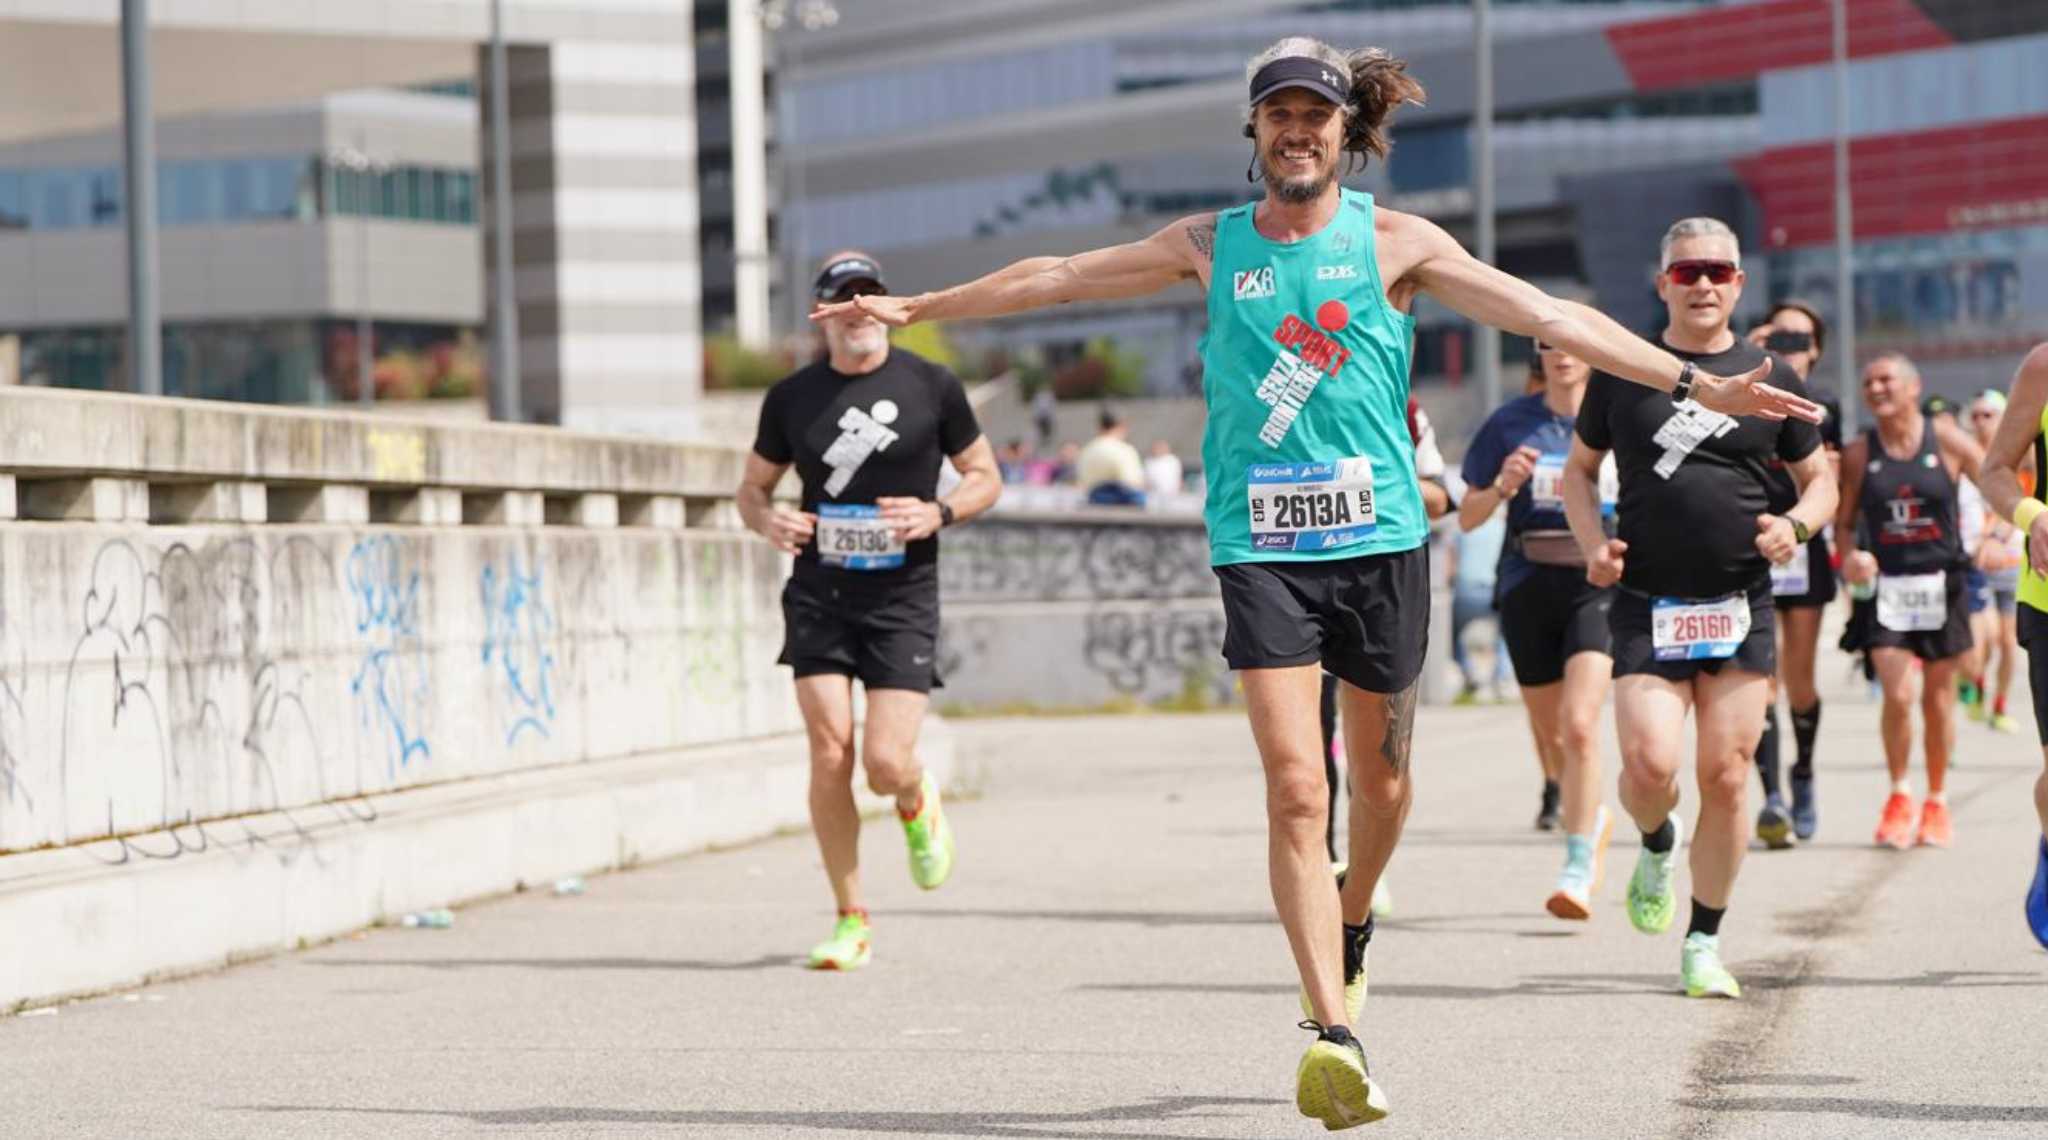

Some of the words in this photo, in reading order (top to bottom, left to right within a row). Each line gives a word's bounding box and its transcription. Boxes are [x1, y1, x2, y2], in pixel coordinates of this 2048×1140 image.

[1234, 267, 1276, 292] DKR
[1272, 314, 1352, 378] SPORT
[1255, 350, 1302, 406] SENZA
[1258, 360, 1323, 449] FRONTIERE
[1274, 491, 1352, 528] 2613A
